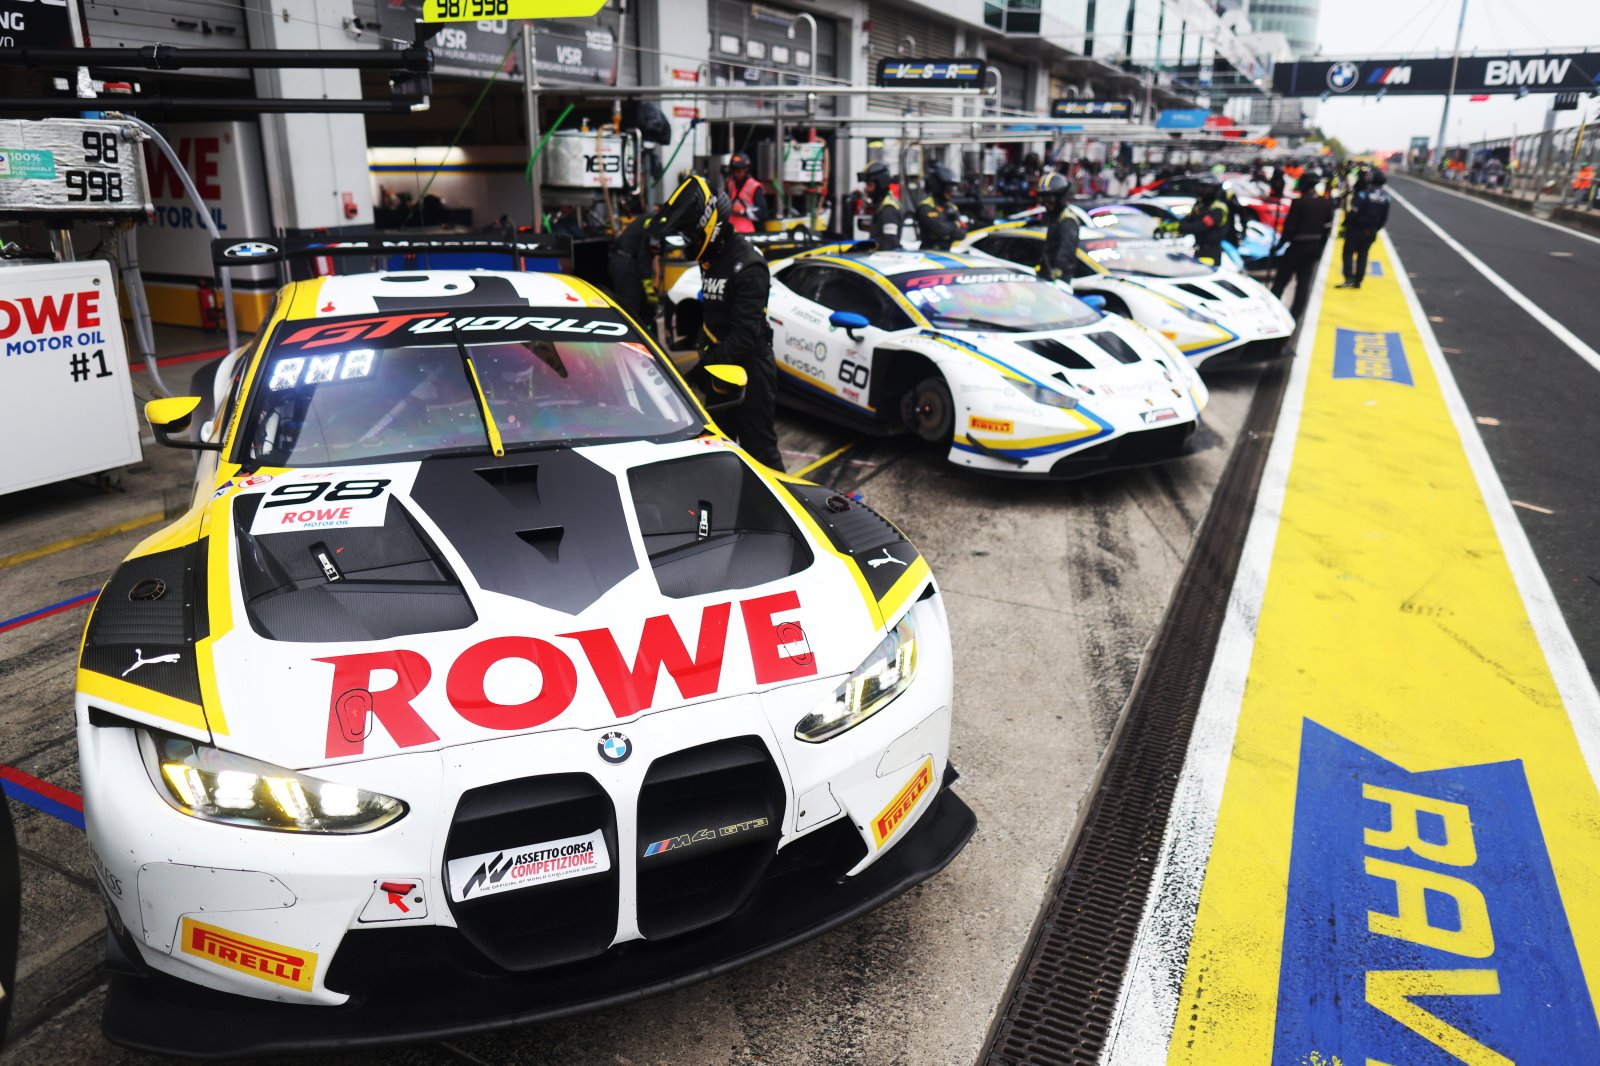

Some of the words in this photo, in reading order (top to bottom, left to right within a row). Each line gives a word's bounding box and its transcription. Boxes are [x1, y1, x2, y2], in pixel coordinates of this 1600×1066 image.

[436, 27, 467, 50] VSR
[556, 45, 582, 66] VSR
[1484, 58, 1572, 86] BMW
[10, 152, 41, 162] 100%
[83, 131, 118, 163] 98
[66, 170, 123, 202] 998
[6, 335, 73, 357] MOTOR
[78, 331, 105, 346] OIL
[280, 312, 449, 350] GT
[70, 349, 113, 382] #1
[839, 359, 869, 389] 60
[263, 479, 392, 508] 98
[281, 507, 353, 524] ROWE
[311, 590, 817, 759] ROWE
[878, 767, 928, 839] PIRELLI
[719, 817, 769, 836] GT3
[511, 851, 594, 879] COMPETIZIONE
[515, 847, 559, 866] ASSETTO
[561, 841, 594, 856] CORSA
[492, 881, 517, 890] OFFICIAL
[548, 868, 580, 877] CHALLENGE
[192, 927, 304, 982] PIRELLI
